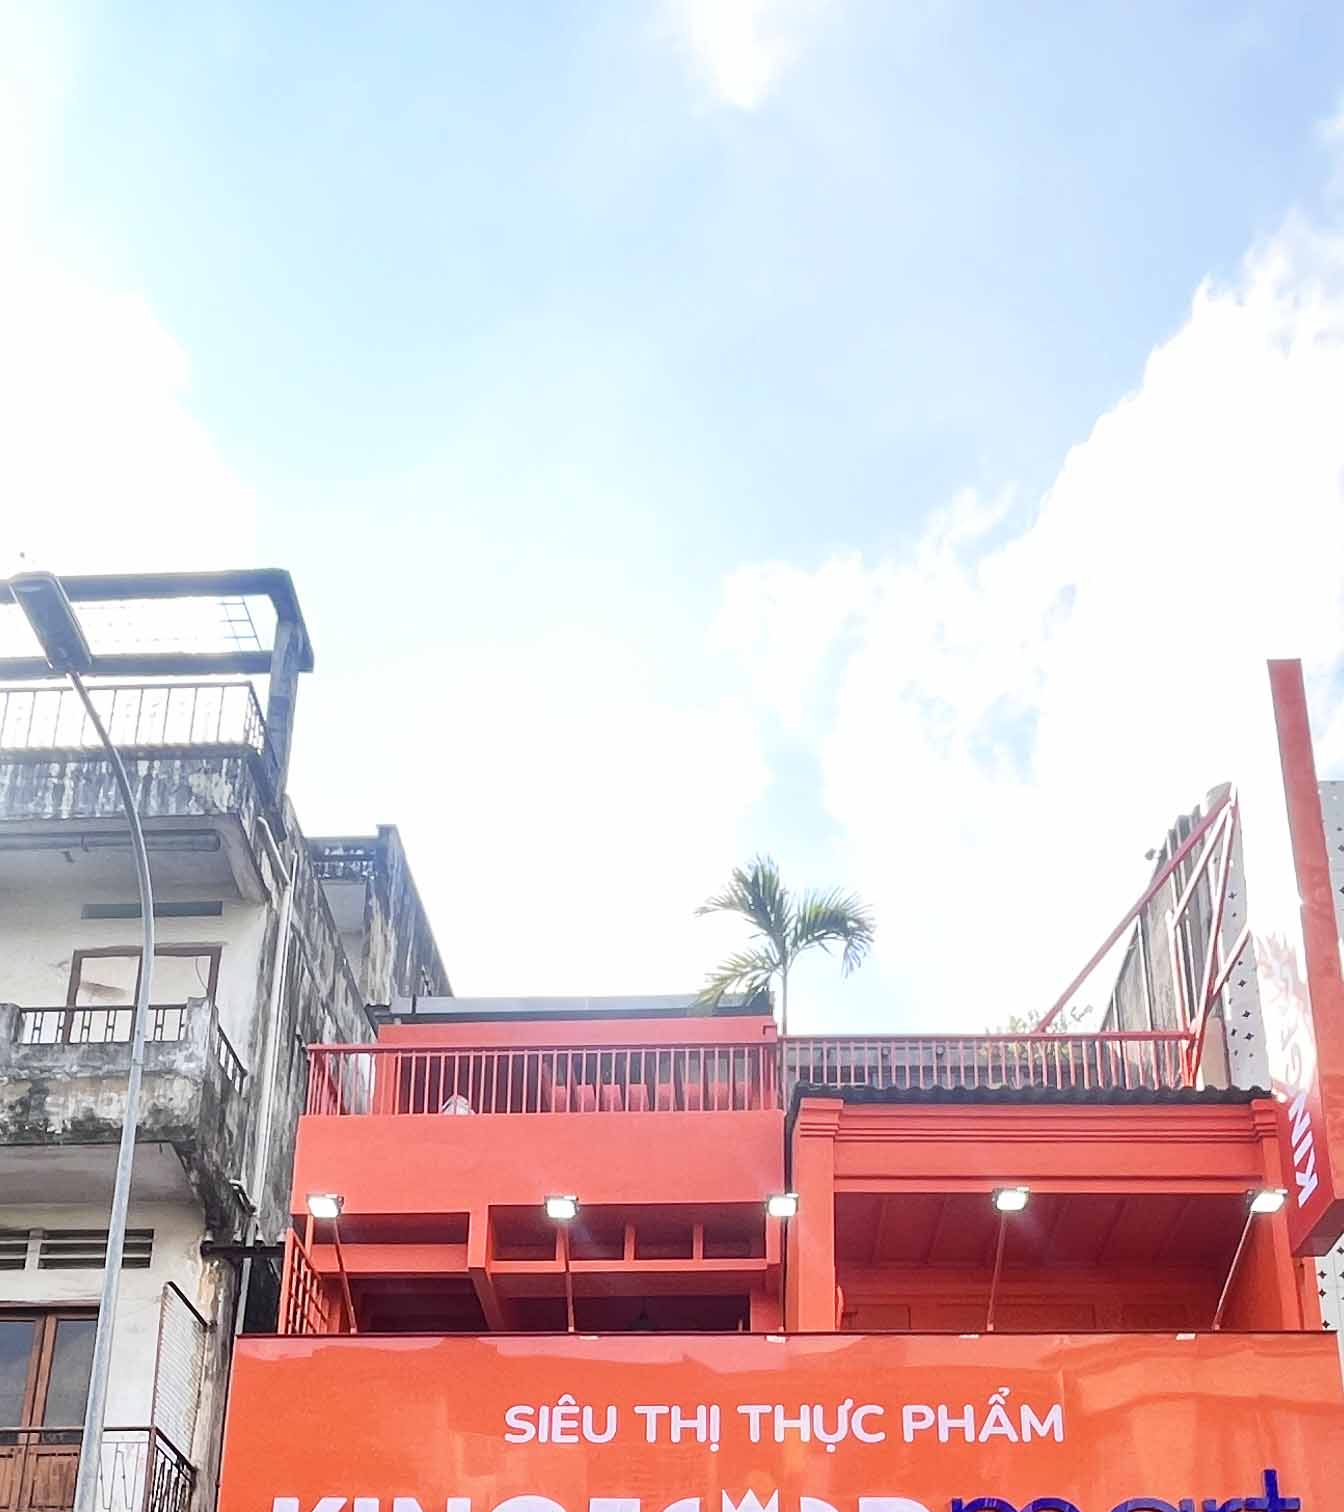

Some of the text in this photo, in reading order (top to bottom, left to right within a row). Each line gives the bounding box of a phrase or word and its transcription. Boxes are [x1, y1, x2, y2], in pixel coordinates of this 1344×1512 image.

[504, 1386, 1065, 1453] SIÊU THỊ THỰC PHẨM
